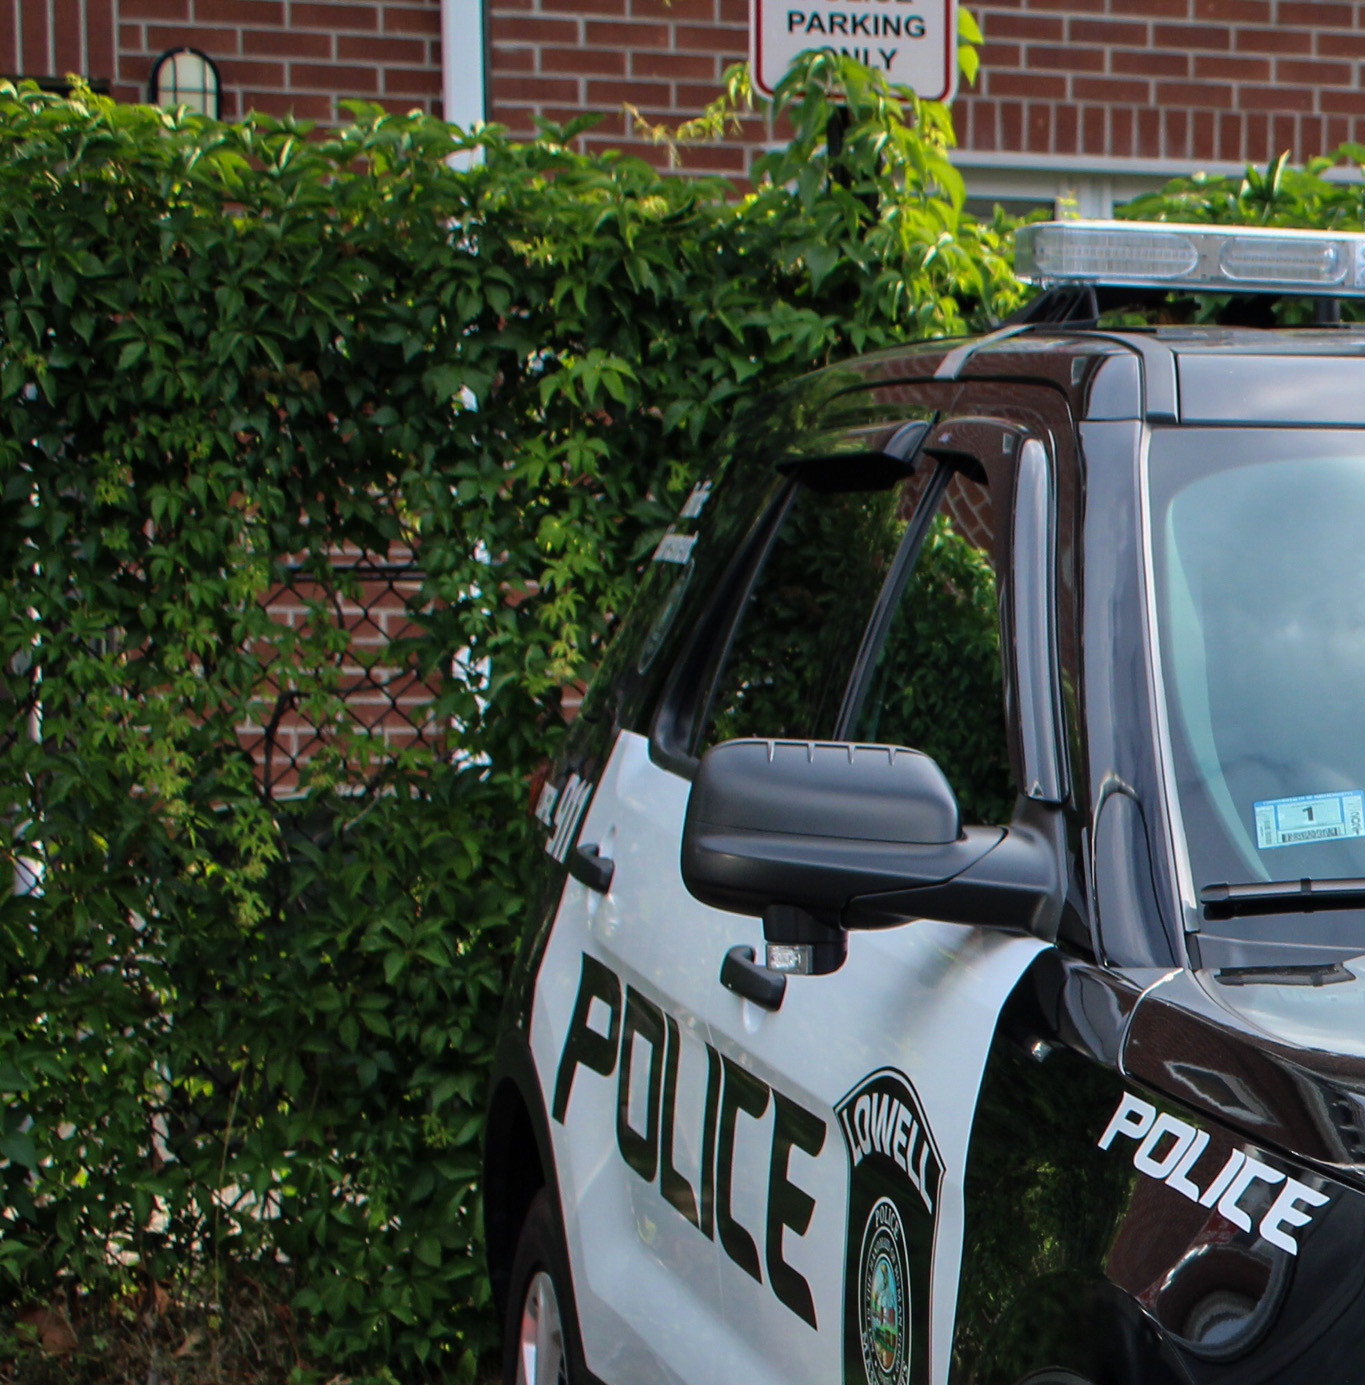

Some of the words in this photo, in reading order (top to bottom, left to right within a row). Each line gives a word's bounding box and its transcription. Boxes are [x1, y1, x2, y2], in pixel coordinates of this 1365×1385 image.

[787, 10, 927, 38] PARKING
[1302, 806, 1314, 822] 1
[551, 951, 827, 1331] POLICE
[842, 1092, 935, 1214] LOWELL
[1097, 1090, 1331, 1256] POLICE
[875, 1205, 900, 1240] POLICE
